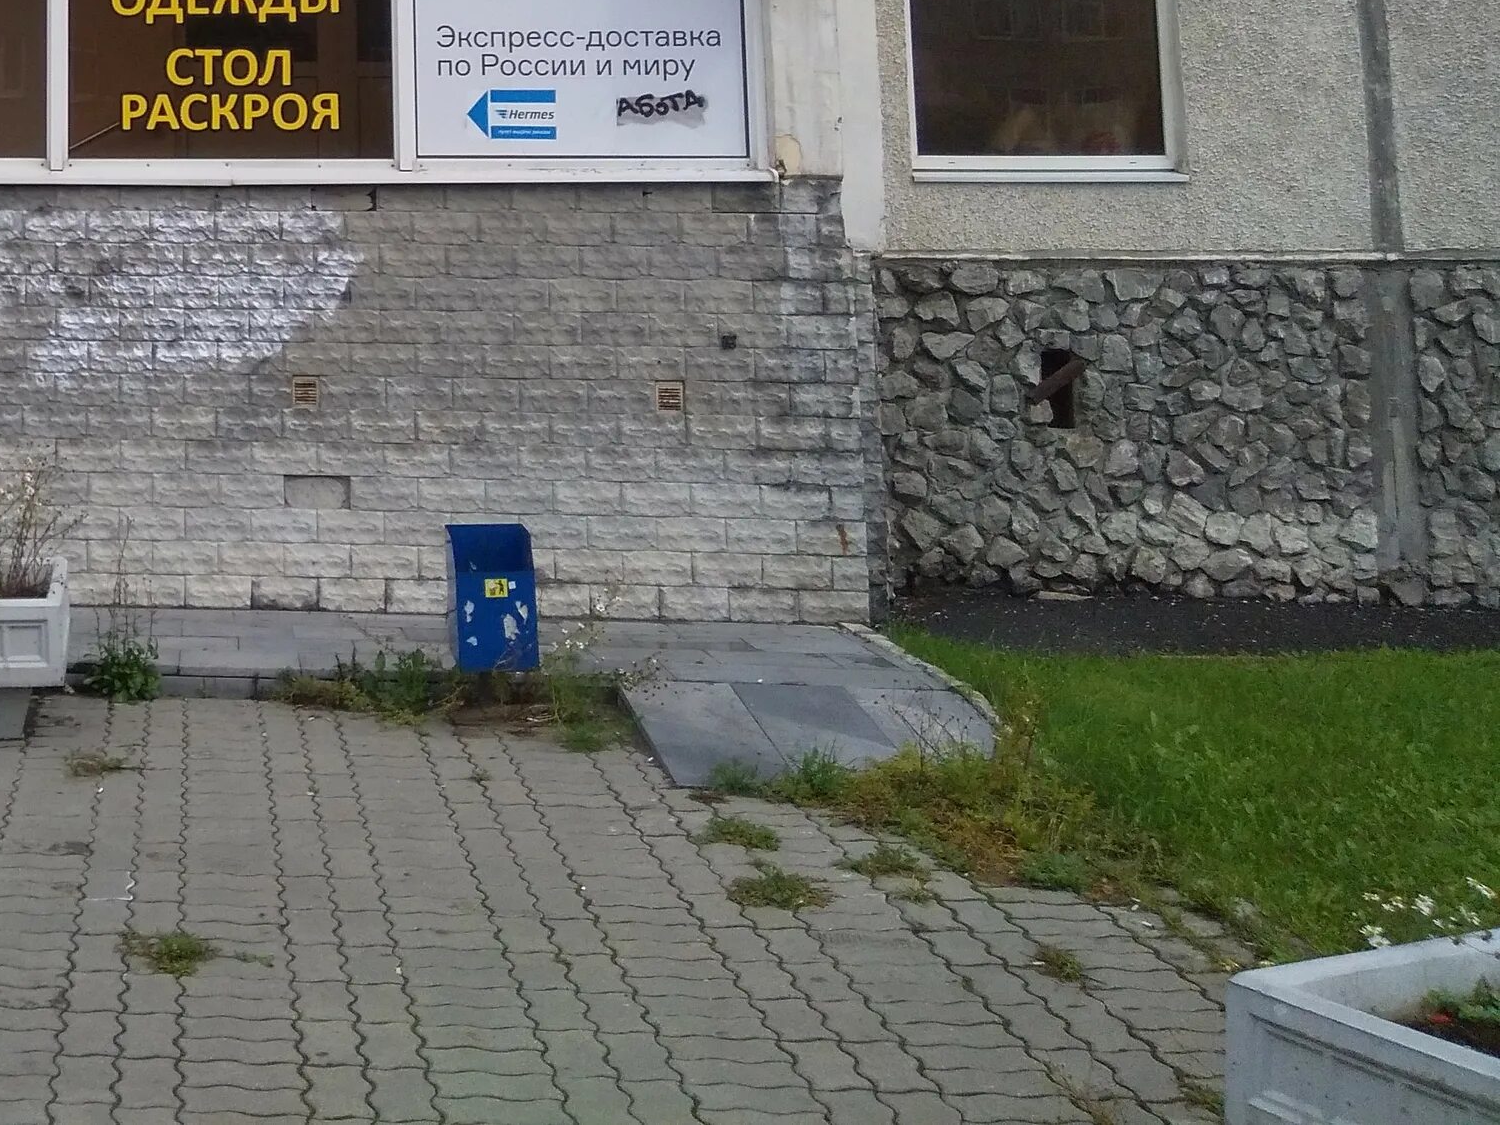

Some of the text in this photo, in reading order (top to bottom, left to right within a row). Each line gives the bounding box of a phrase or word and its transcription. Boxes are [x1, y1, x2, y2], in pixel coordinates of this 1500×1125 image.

[436, 24, 722, 53] Экспресс-доставка
[165, 47, 292, 86] СТОЛ
[437, 53, 696, 81] по России и миру
[121, 92, 341, 131] РАСКРОЯ
[508, 109, 555, 120] Hermes
